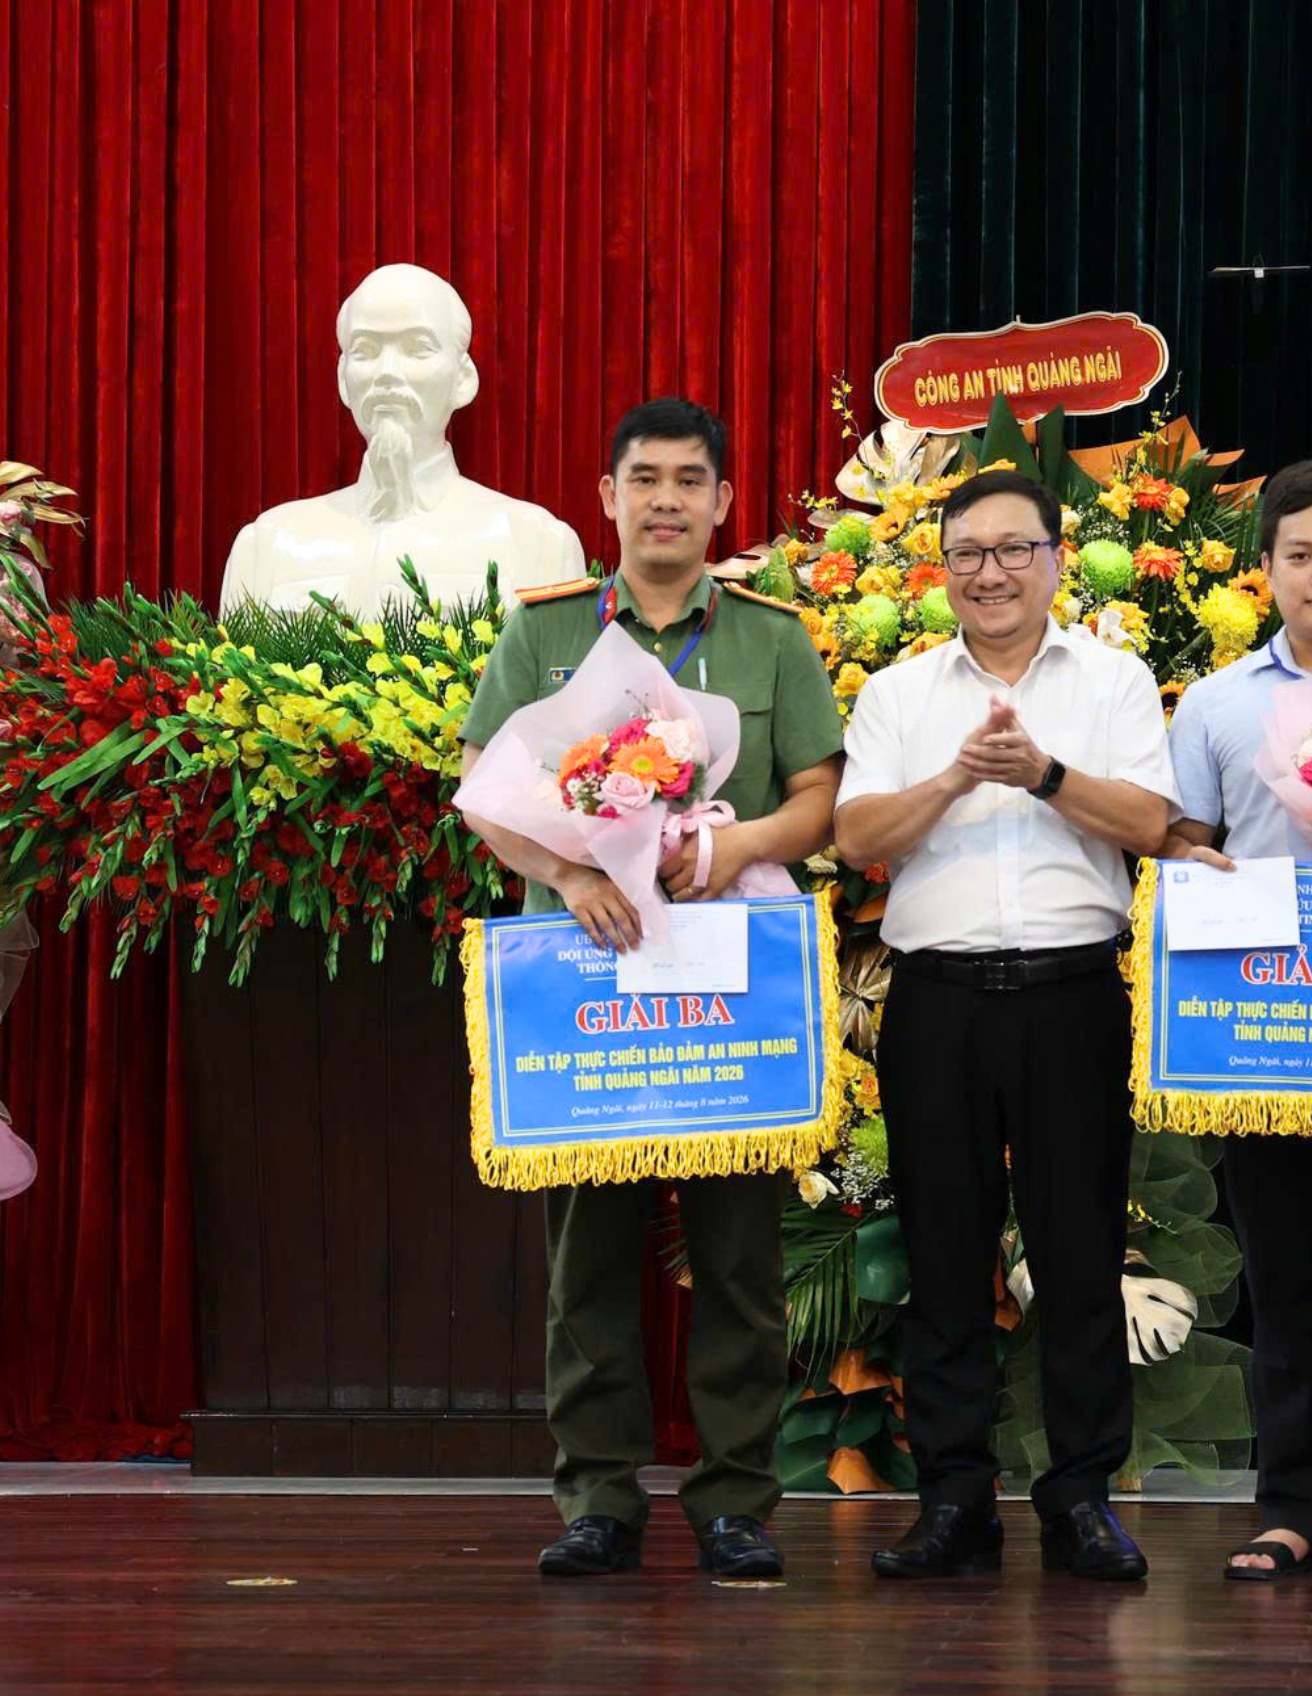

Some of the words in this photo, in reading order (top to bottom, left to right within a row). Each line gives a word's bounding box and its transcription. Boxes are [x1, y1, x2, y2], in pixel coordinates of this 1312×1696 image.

[963, 368, 985, 401] AN
[676, 993, 735, 1028] BA
[1271, 999, 1307, 1020] CHIẾN
[609, 1044, 646, 1066] CHIẾN
[708, 1043, 725, 1060] AN
[728, 1041, 758, 1058] NINH
[761, 1038, 798, 1059] MẠNG
[714, 1065, 744, 1081] 2026
